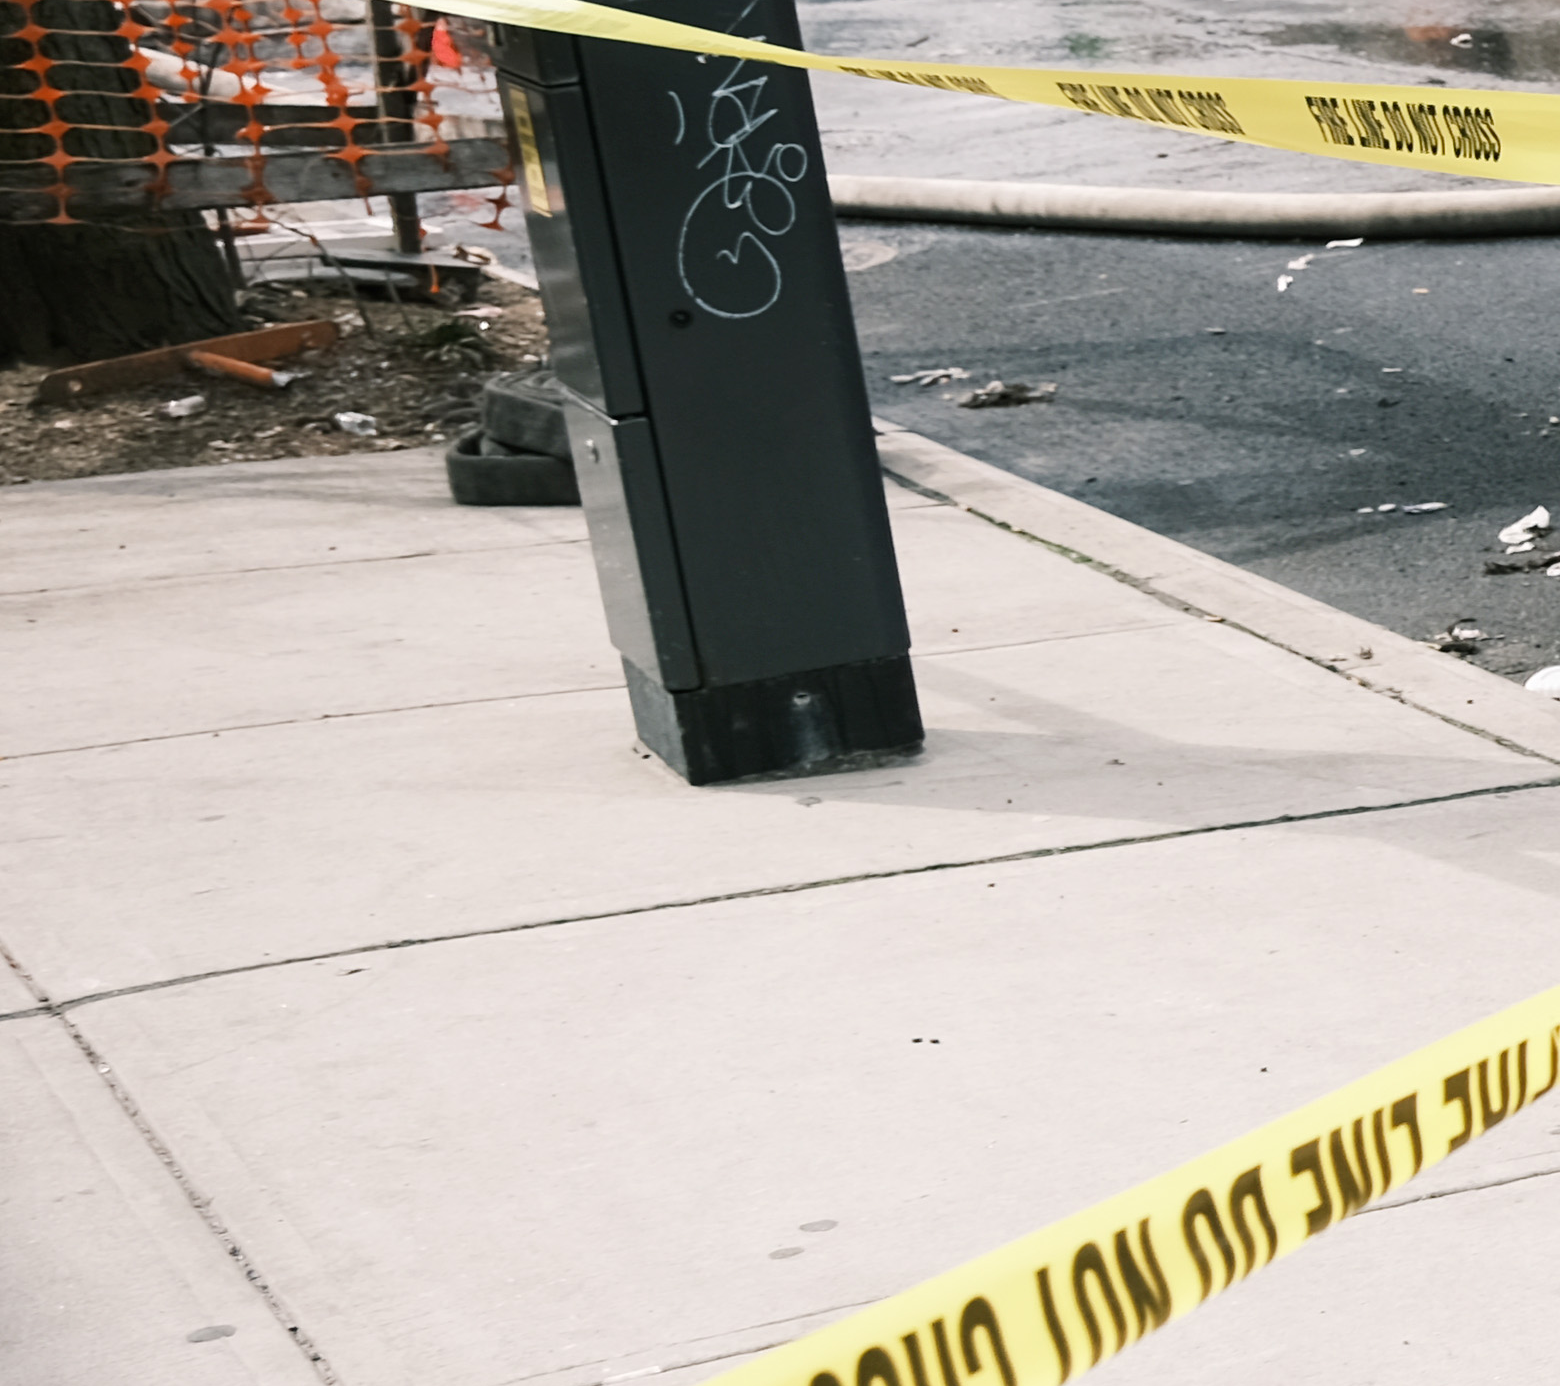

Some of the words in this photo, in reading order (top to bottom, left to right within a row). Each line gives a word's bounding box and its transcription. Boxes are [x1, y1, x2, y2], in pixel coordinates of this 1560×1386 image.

[1305, 96, 1354, 146] FIRE
[1342, 99, 1391, 150] LINE
[1380, 101, 1414, 153] DO
[1405, 103, 1446, 156] NOT
[1442, 105, 1502, 162] CROSS
[1181, 1165, 1278, 1301] DO
[1290, 1092, 1425, 1239] LINE
[1035, 1217, 1171, 1386] NOT
